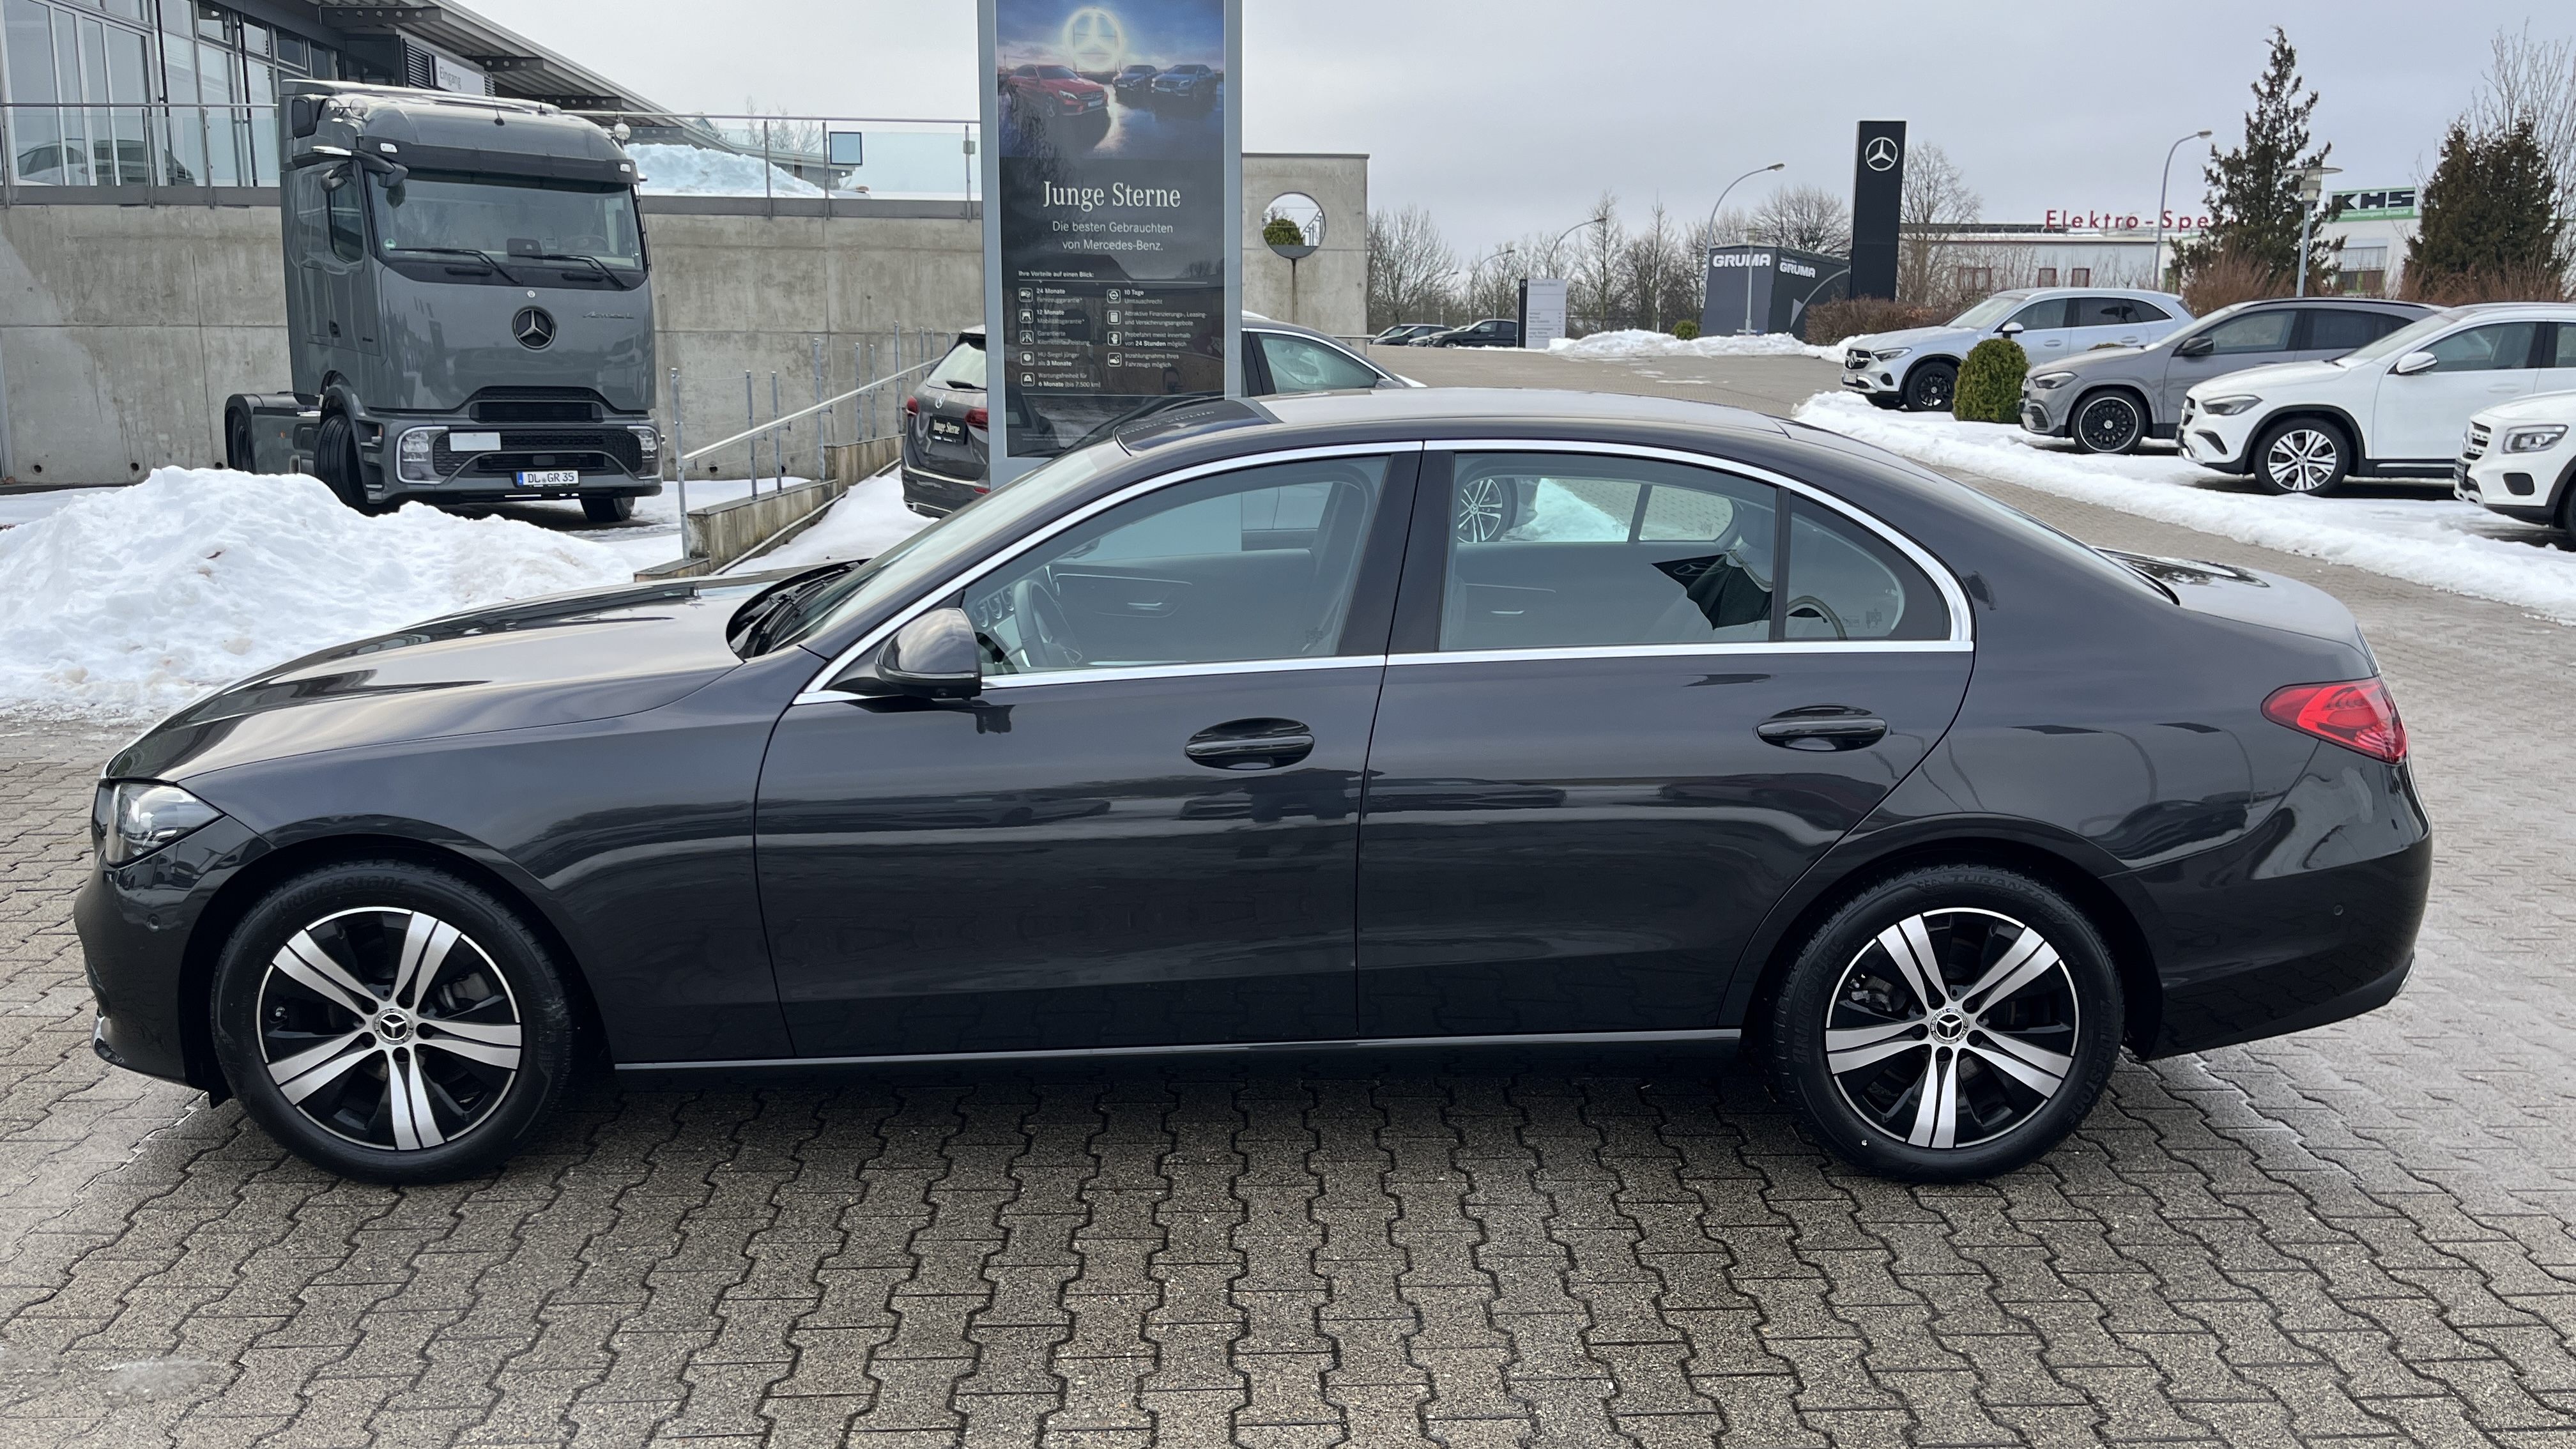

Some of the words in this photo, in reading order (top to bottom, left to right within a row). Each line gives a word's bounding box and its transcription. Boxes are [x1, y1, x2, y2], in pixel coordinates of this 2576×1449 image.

[1043, 181, 1105, 212] Junge
[1112, 181, 1181, 208] Sterne
[1052, 221, 1069, 232] Die
[1073, 222, 1106, 233] besten
[1109, 222, 1173, 234] Gebrauchten
[2046, 210, 2235, 232] Elektro-Spe
[1062, 241, 1080, 250] von
[1084, 240, 1163, 251] Mercedes-Benz.
[1712, 254, 1771, 267] GRUMA
[1779, 262, 1816, 279] GRUMA
[933, 419, 946, 434] Junge
[946, 422, 960, 434] Sterne
[527, 473, 540, 483] DL
[548, 473, 560, 482] GR
[562, 473, 574, 482] 35
